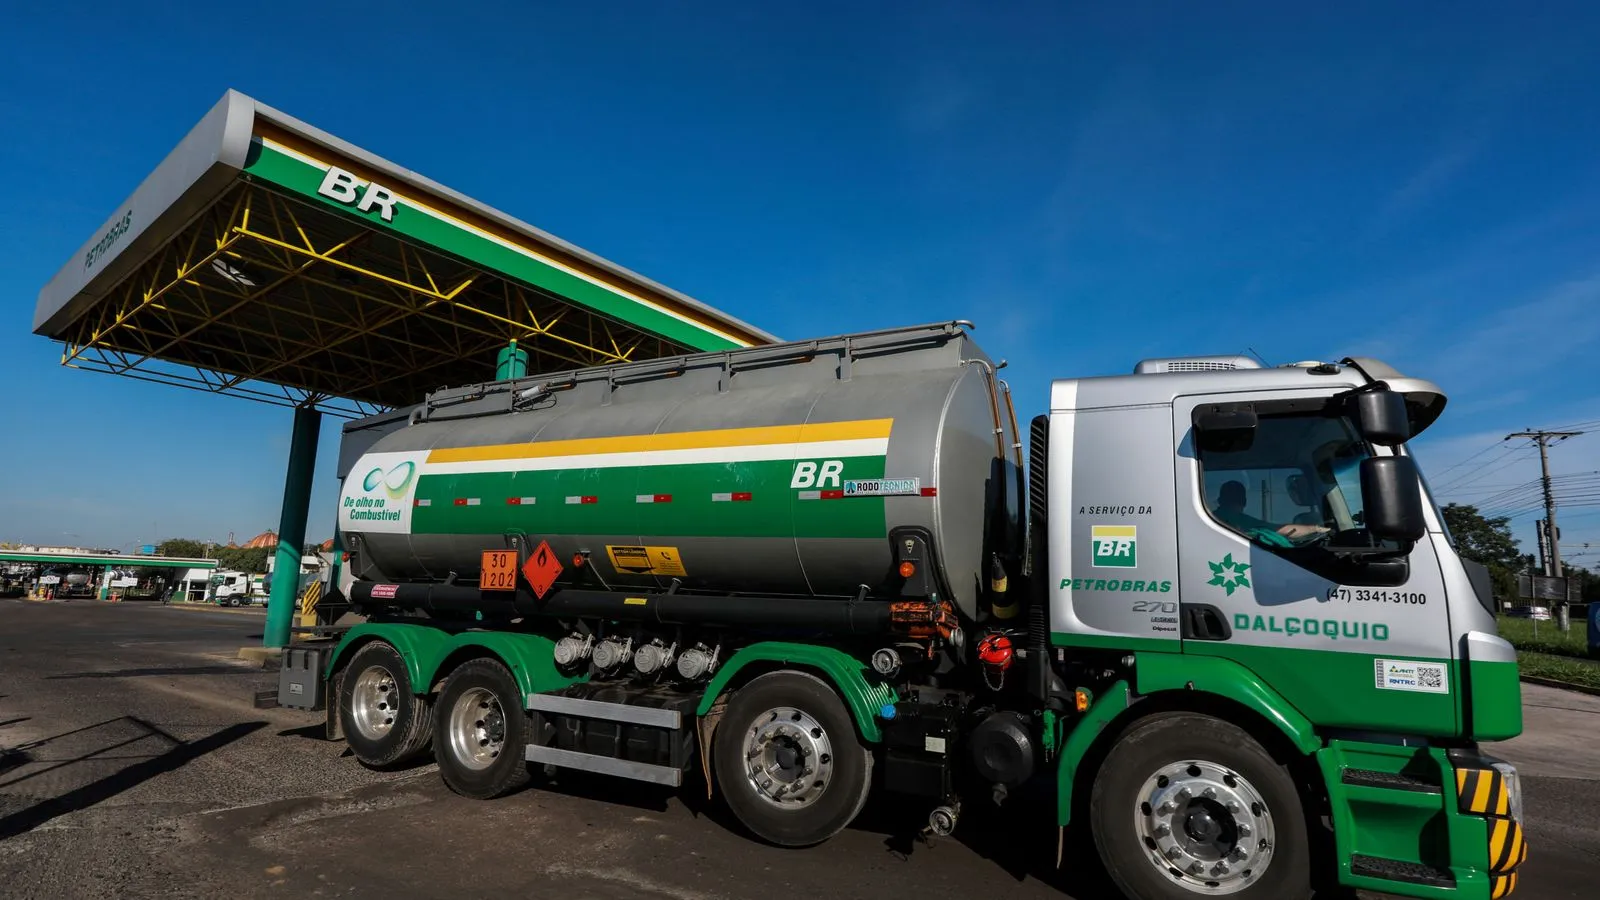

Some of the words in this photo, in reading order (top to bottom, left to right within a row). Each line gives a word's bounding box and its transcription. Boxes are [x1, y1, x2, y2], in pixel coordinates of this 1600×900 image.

[317, 165, 396, 221] BR
[83, 209, 132, 274] PETROBRAS
[790, 460, 844, 488] BR
[344, 496, 354, 508] De
[355, 497, 373, 508] olho
[374, 499, 385, 508] no
[350, 509, 401, 521] Combustível
[1079, 506, 1085, 515] A
[1088, 505, 1135, 516] SERVIÇO
[1138, 505, 1152, 515] DA
[1097, 540, 1132, 557] BR
[491, 553, 507, 568] 30
[483, 572, 513, 587] 1202
[1059, 578, 1172, 593] PETROBRAS
[1326, 588, 1351, 603] (47)
[1355, 590, 1426, 605] 3341-3100
[1132, 600, 1178, 613] 270
[1233, 613, 1390, 641] DALÇOQUIO
